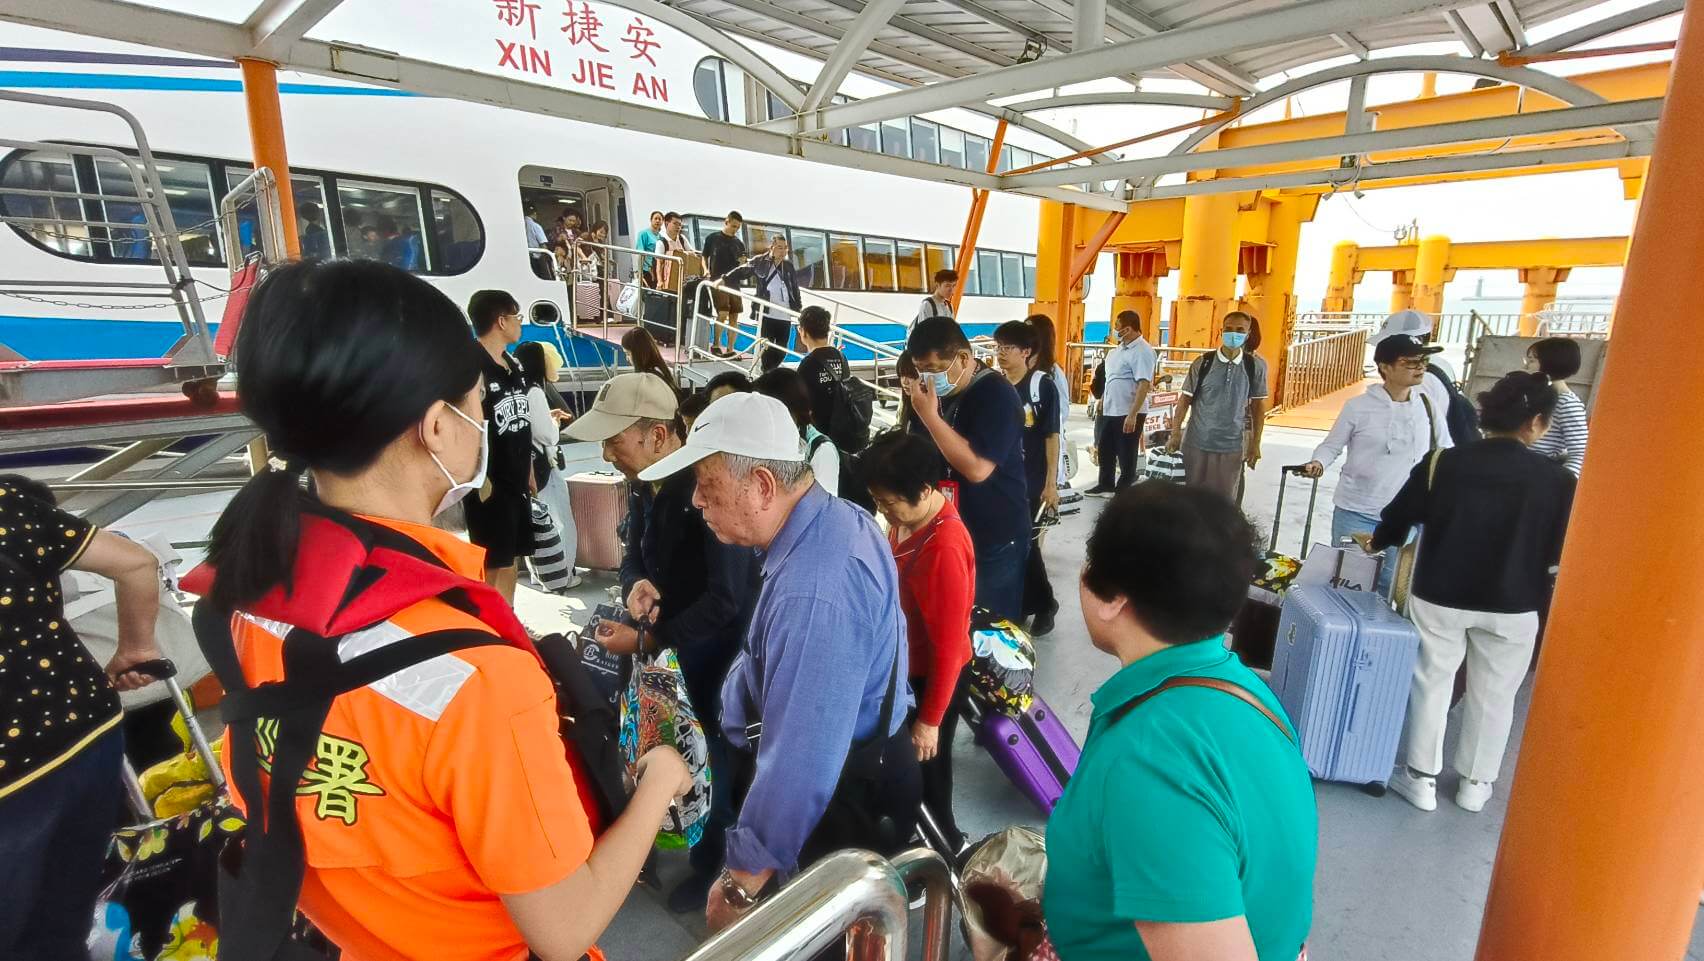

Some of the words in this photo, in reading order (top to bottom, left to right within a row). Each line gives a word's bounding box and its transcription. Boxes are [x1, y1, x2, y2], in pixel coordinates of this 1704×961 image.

[493, 0, 662, 67] 新捷安
[495, 39, 552, 77] XIN
[572, 58, 616, 91] JIE
[632, 72, 668, 102] AN
